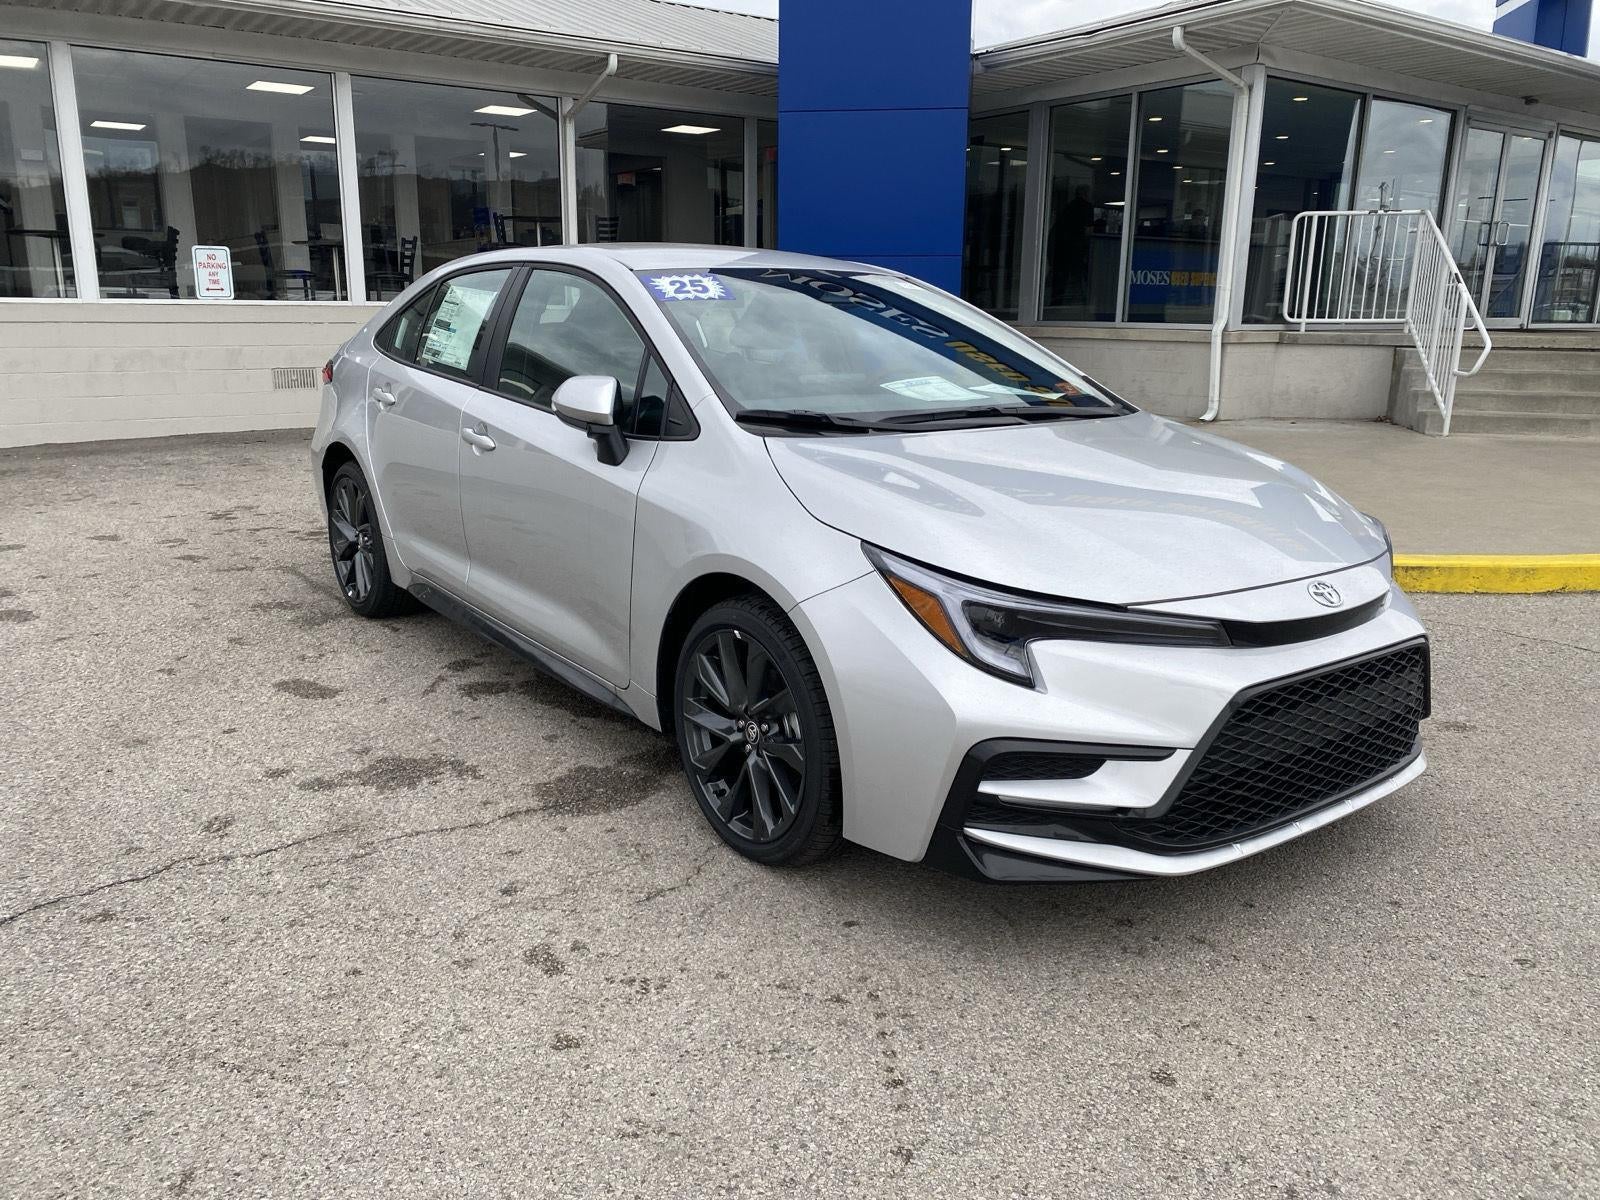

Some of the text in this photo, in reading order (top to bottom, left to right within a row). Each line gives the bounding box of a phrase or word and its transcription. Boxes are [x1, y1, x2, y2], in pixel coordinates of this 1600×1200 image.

[206, 253, 217, 261] NO
[198, 262, 227, 270] PARKING
[208, 278, 220, 286] TIME
[1129, 270, 1170, 286] MOSES
[668, 279, 710, 295] 25
